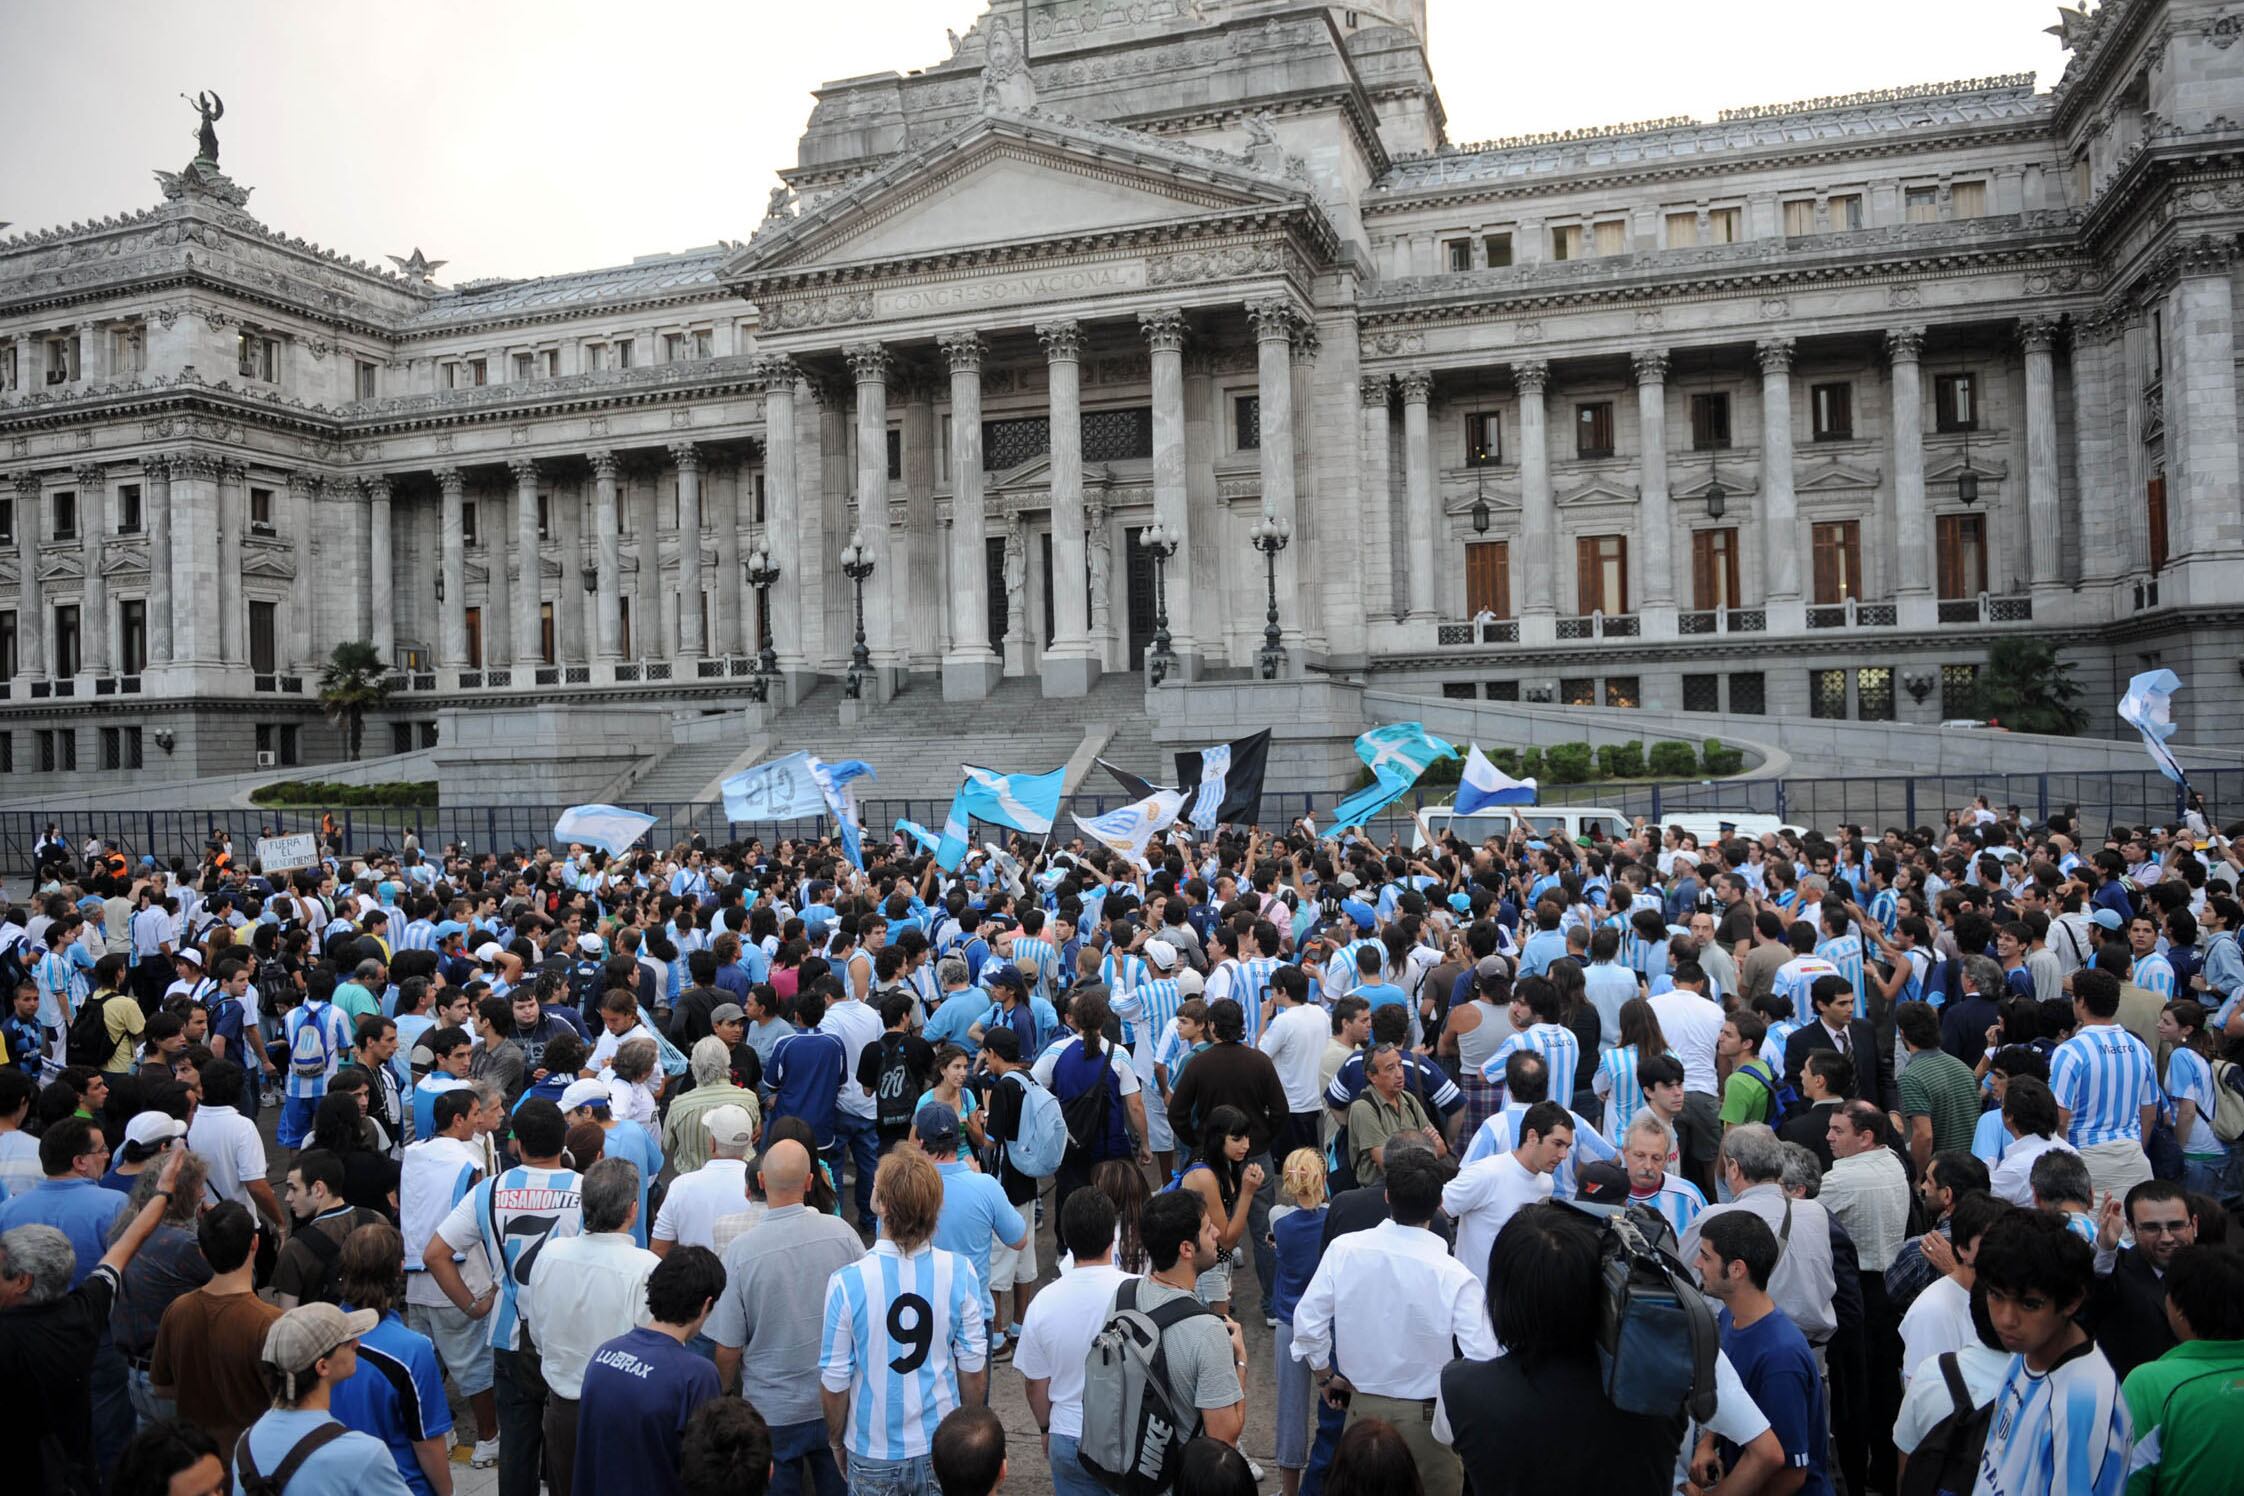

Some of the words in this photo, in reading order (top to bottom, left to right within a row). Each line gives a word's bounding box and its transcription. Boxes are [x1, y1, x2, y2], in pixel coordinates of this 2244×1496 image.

[894, 282, 1009, 311] CONGRESO
[1020, 269, 1128, 298] NACIONAL
[1542, 1037, 1573, 1048] Macro
[2098, 1043, 2136, 1055] Macro
[502, 1215, 561, 1287] 7
[886, 1292, 934, 1376] 9
[595, 1349, 655, 1379] LUBRAX
[1138, 1412, 1174, 1481] NIKE
